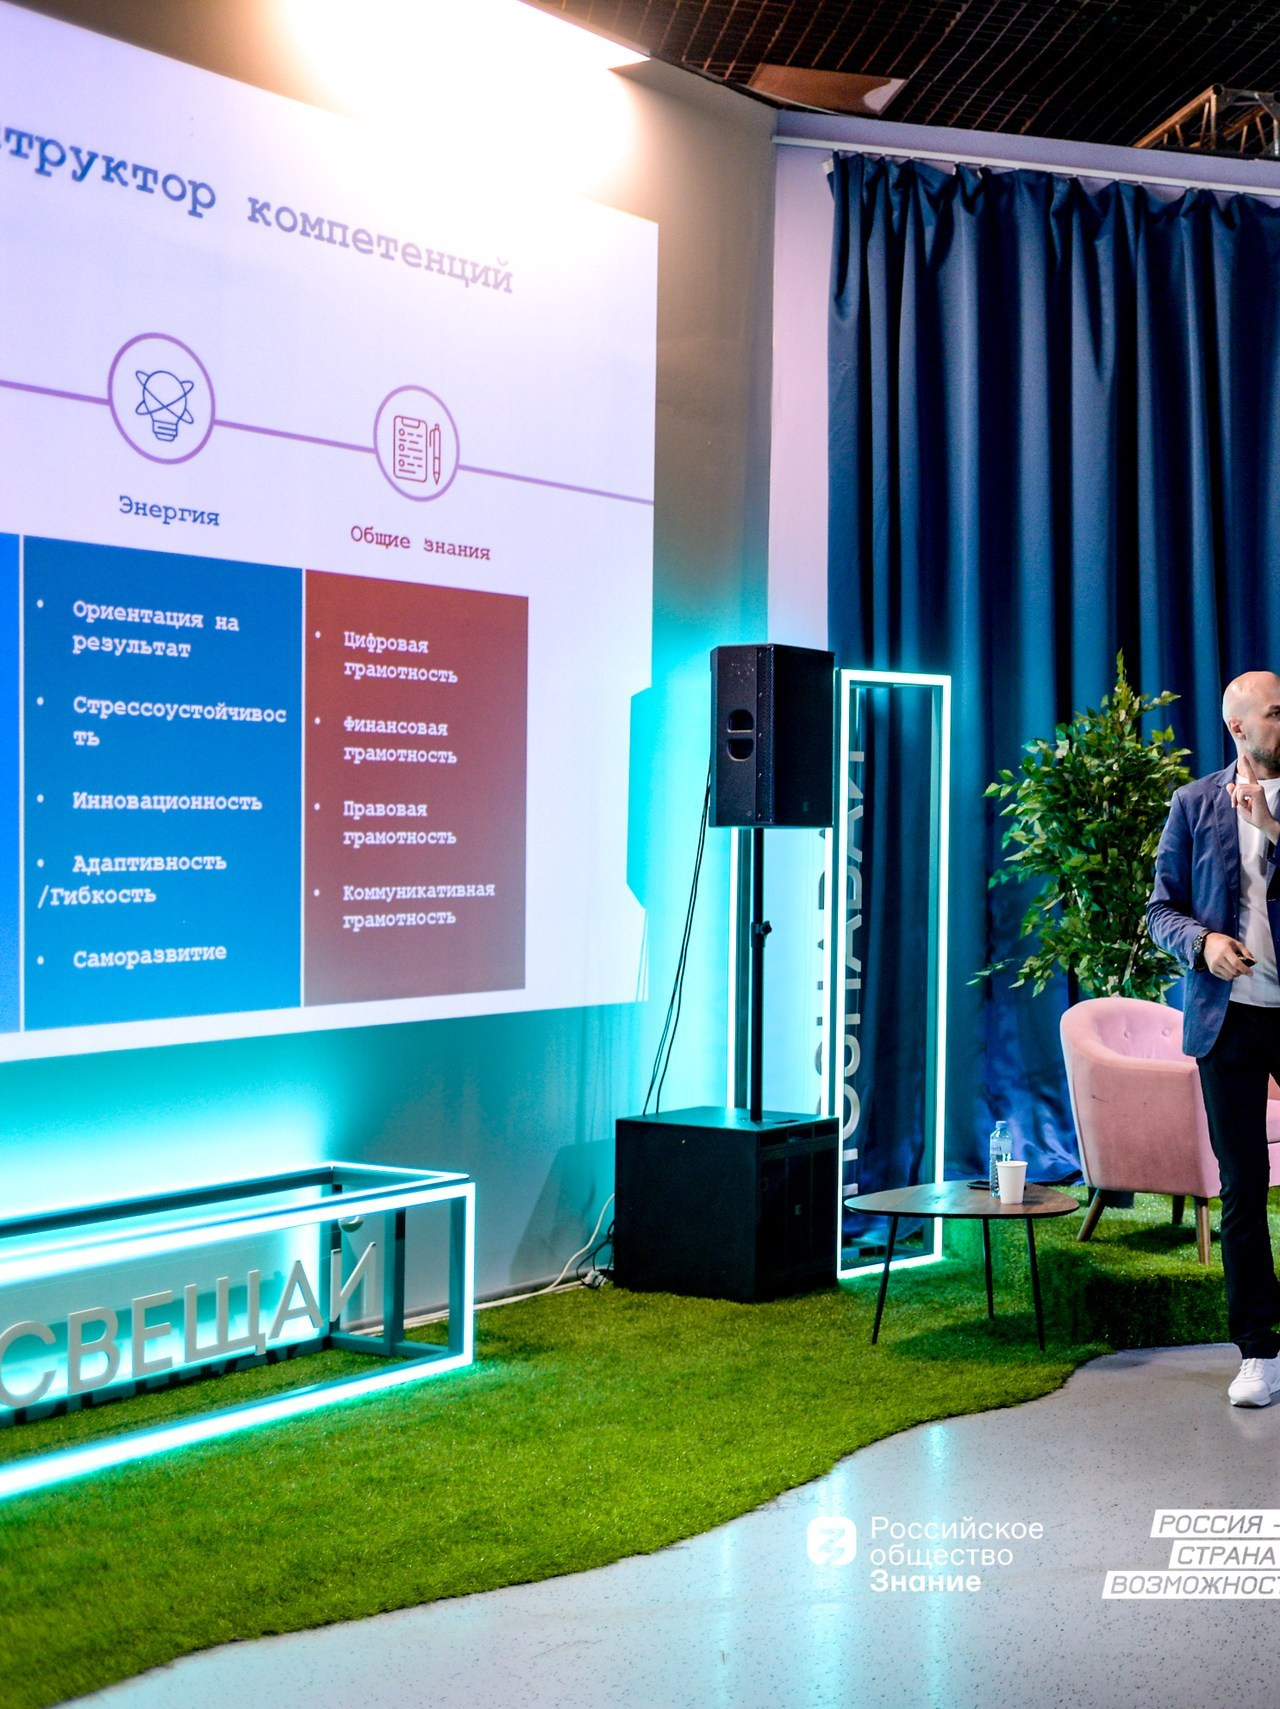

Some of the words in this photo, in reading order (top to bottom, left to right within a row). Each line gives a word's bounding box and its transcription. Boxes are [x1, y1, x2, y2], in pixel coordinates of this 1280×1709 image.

[0, 126, 217, 219] труктор
[247, 196, 514, 294] компетенций
[119, 495, 220, 527] Энергия
[350, 525, 411, 550] Общие
[423, 538, 491, 561] знания
[72, 600, 204, 630] Ориентация
[214, 615, 240, 632] на
[72, 635, 192, 658] результат
[343, 630, 429, 654] Цифровая
[343, 661, 458, 684] грамотность
[73, 695, 287, 723] Стрессоустойчивос
[343, 715, 449, 737] Финансовая
[73, 730, 100, 746] ть
[343, 746, 458, 765] грамотность
[72, 791, 263, 813] Инновационность
[343, 800, 428, 821] Правовая
[343, 831, 457, 849] грамотность
[72, 855, 227, 876] Адаптивность
[37, 884, 157, 909] /Гибкость
[342, 883, 496, 903] Коммуникативная
[342, 911, 457, 933] грамотность
[73, 945, 227, 970] Саморазвитие
